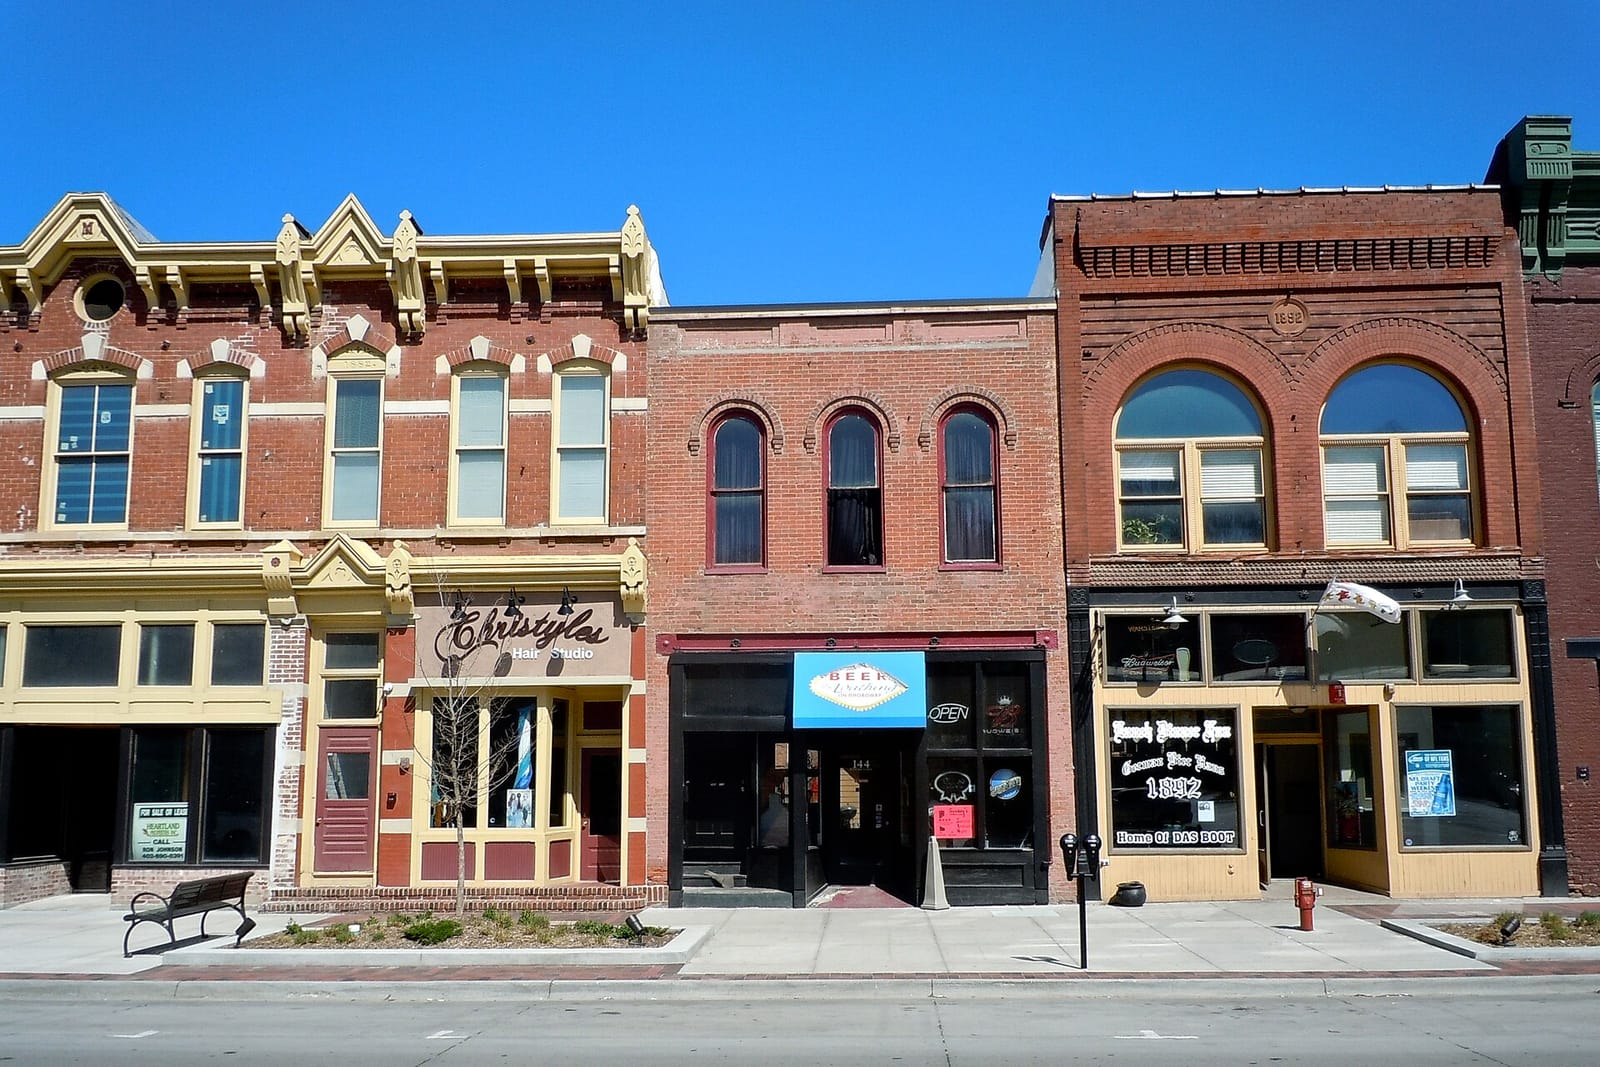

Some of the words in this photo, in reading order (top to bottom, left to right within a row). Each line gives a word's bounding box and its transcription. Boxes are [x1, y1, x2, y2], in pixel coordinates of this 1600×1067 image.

[512, 647, 540, 659] Hair
[551, 647, 594, 659] Studio
[829, 672, 887, 681] BEER
[928, 706, 969, 720] OPEN
[1112, 720, 1153, 744] Lunch
[1156, 720, 1201, 744] Dinner
[853, 759, 870, 769] 144
[1121, 757, 1164, 776] German
[1194, 753, 1226, 775] Haus
[1145, 776, 1202, 799] 1892
[151, 808, 164, 817] SALE
[1116, 831, 1153, 844] Home
[1154, 831, 1169, 844] Of
[1172, 831, 1199, 844] DAS
[1200, 830, 1235, 844] BOOT
